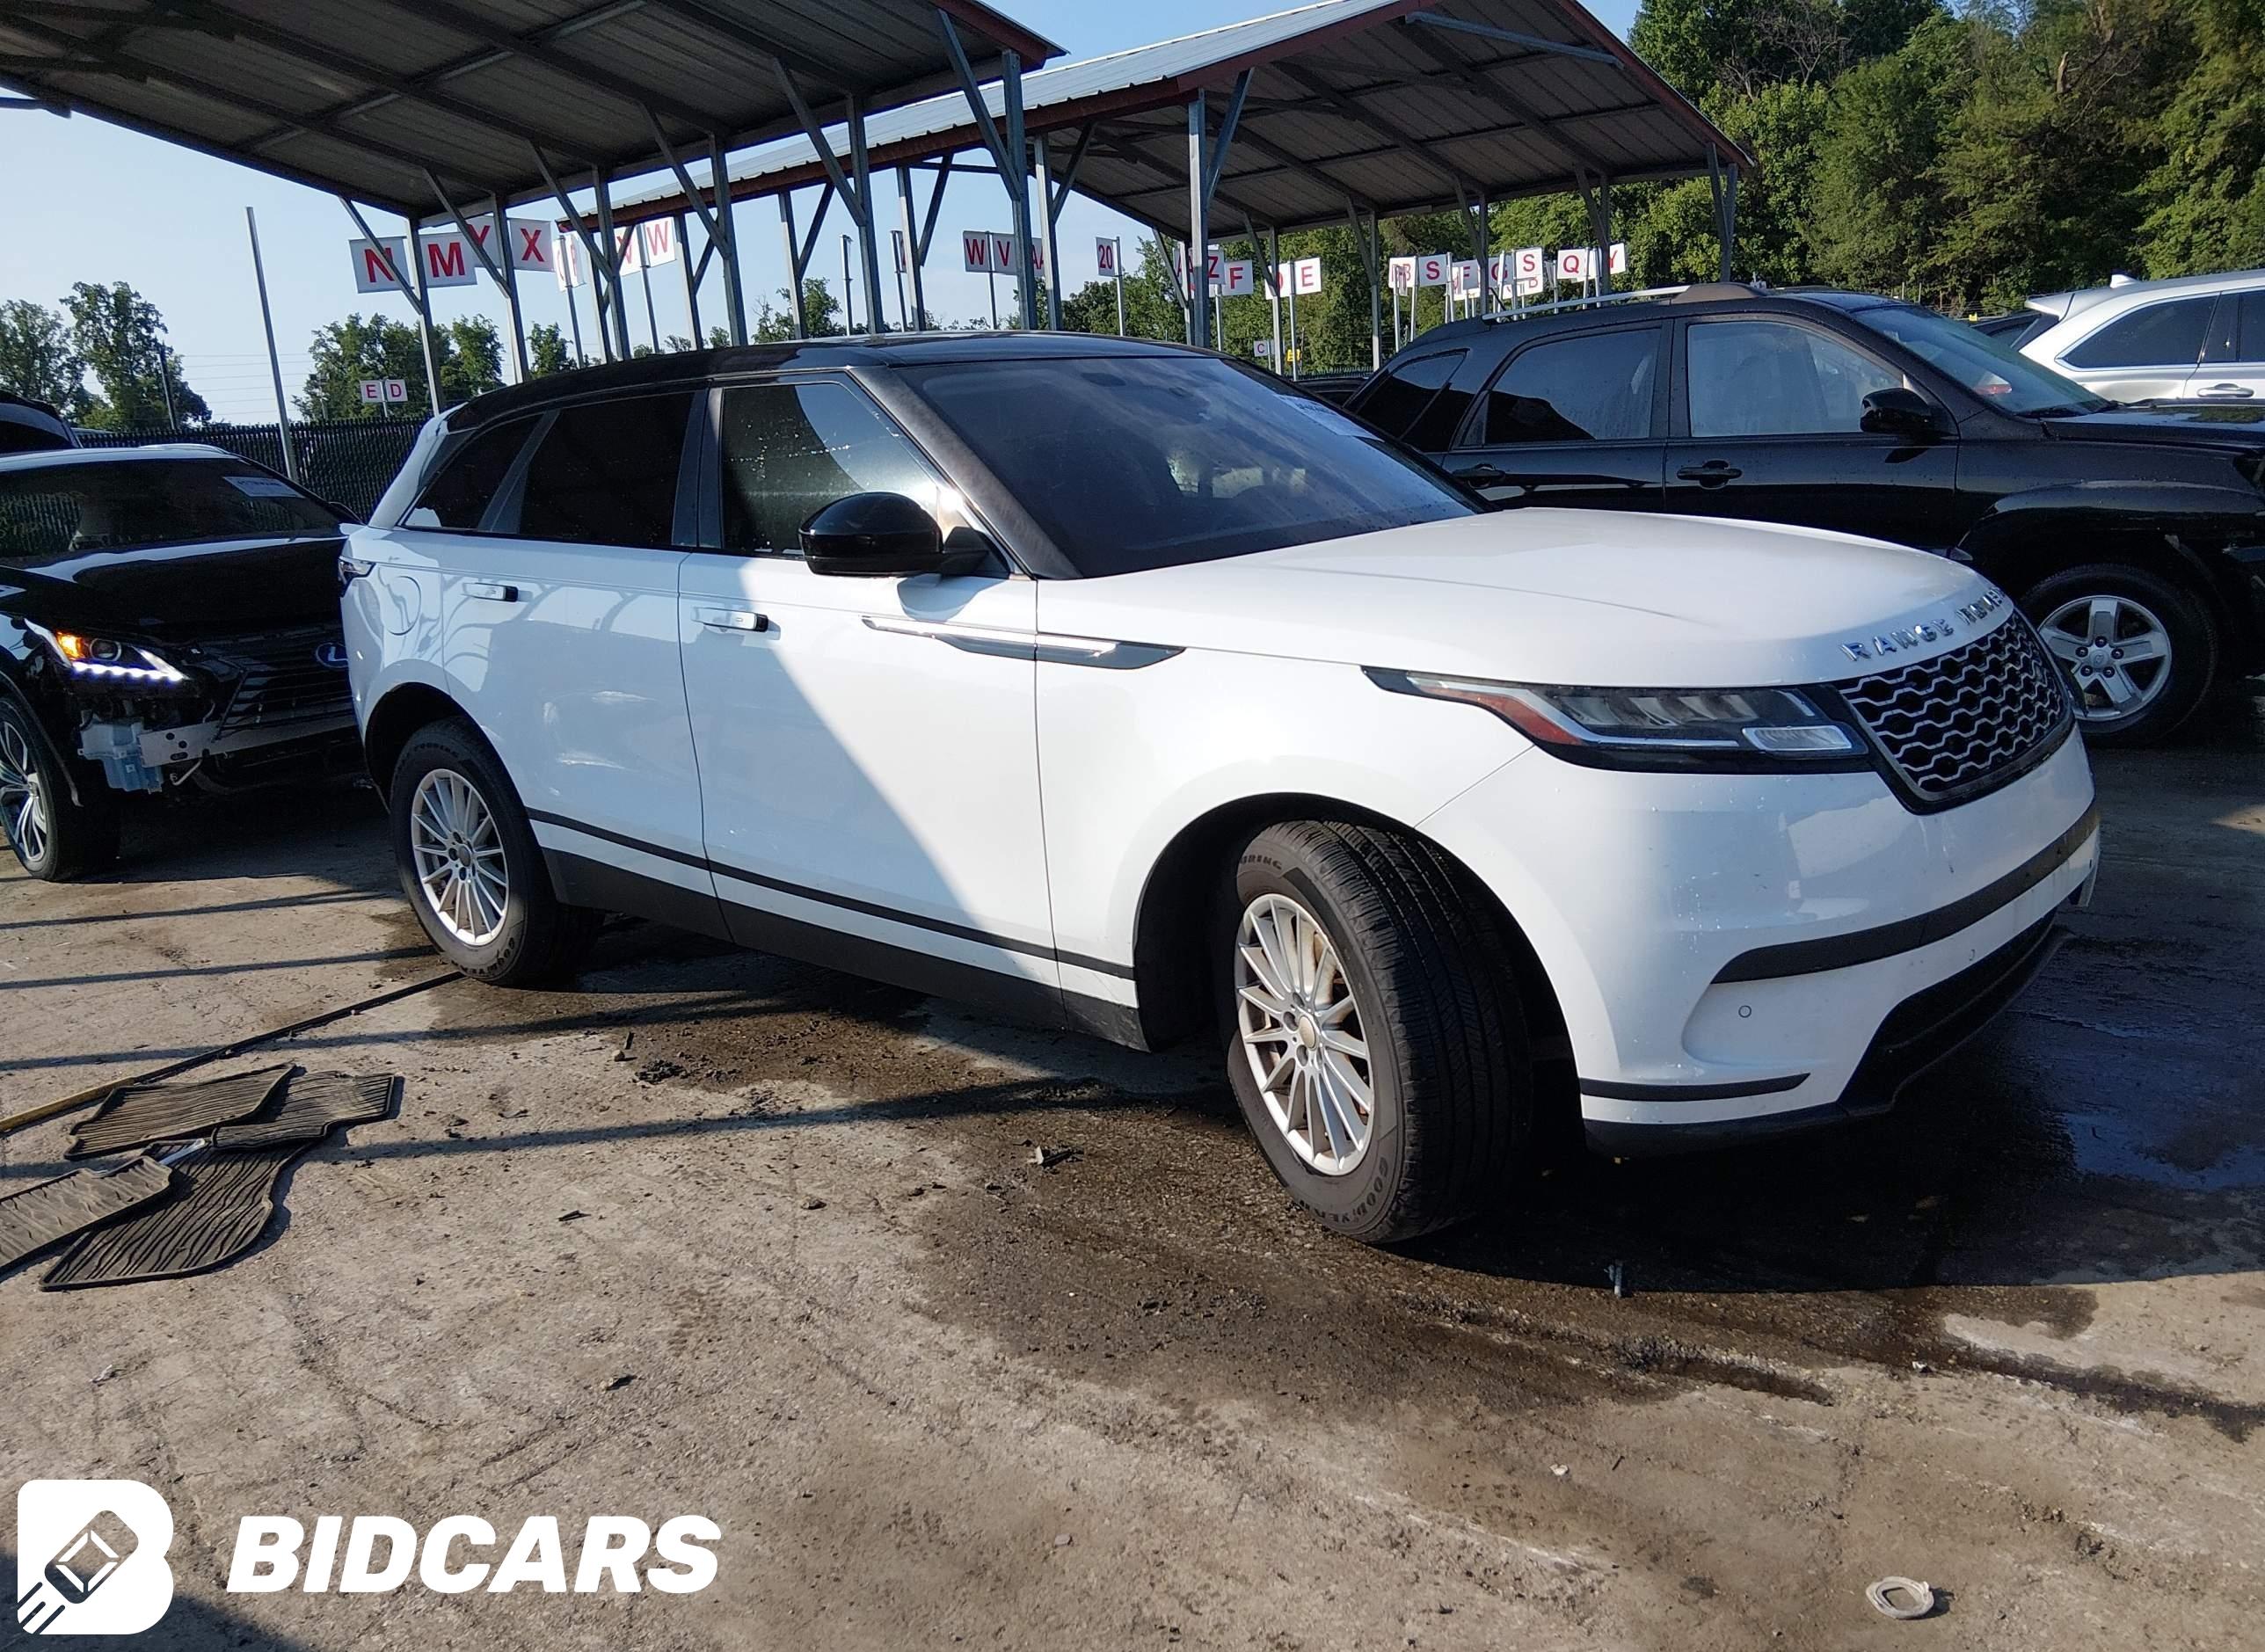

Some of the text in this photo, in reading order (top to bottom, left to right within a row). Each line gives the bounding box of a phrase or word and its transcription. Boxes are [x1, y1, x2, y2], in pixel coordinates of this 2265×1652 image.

[521, 228, 544, 262] X
[646, 221, 668, 257] W
[427, 242, 465, 278] M
[965, 238, 985, 266] W
[997, 240, 1010, 266] V
[1098, 244, 1113, 269] 20
[1523, 253, 1535, 273] S
[364, 247, 395, 283] N
[1207, 256, 1220, 278] Z
[1426, 261, 1440, 280] S
[1562, 255, 1579, 273] Q
[1229, 266, 1243, 289] F
[1301, 266, 1314, 287] E
[1257, 343, 1265, 353] C
[366, 384, 378, 399] E
[390, 383, 402, 397] D
[1840, 618, 1954, 662] RANGE
